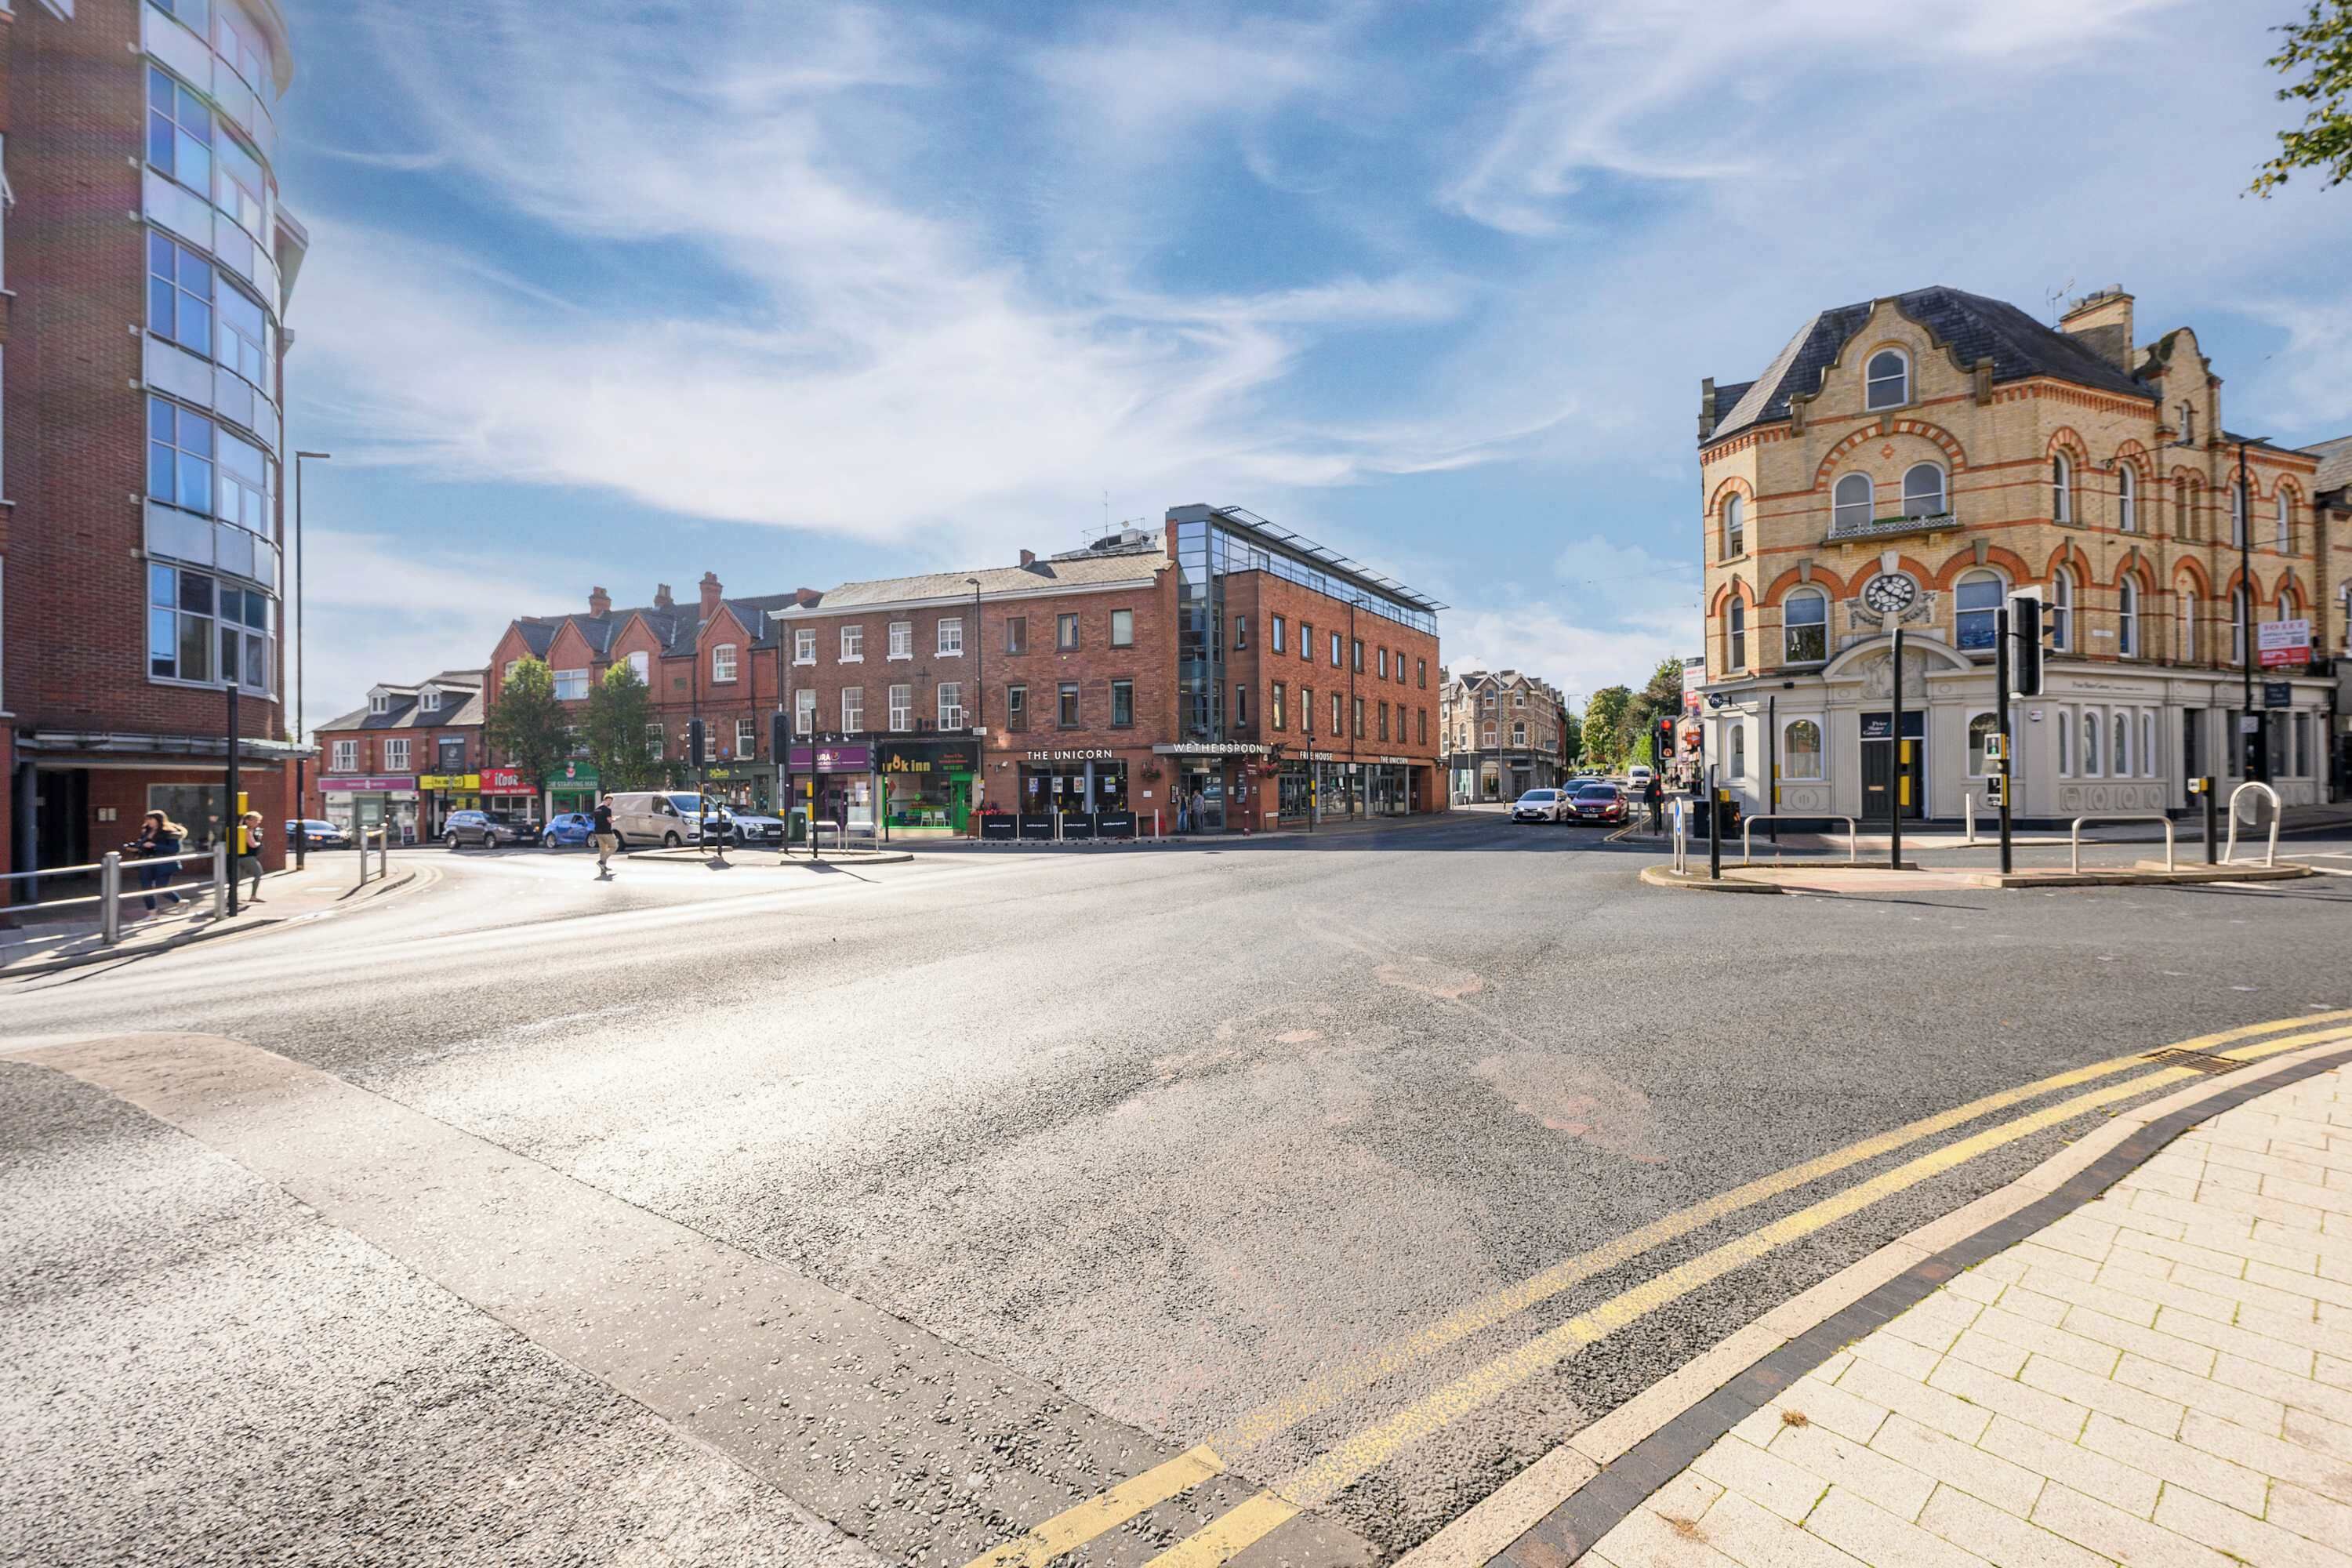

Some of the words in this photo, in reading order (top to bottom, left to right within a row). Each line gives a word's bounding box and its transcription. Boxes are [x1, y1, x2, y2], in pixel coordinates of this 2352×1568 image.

[1174, 743, 1263, 753] WETHERSPOON
[1027, 751, 1048, 760] THE
[1054, 750, 1112, 760] UNICORN
[1315, 752, 1333, 761] HOUSE
[911, 760, 931, 772] inn
[1389, 757, 1408, 765] UNICORN
